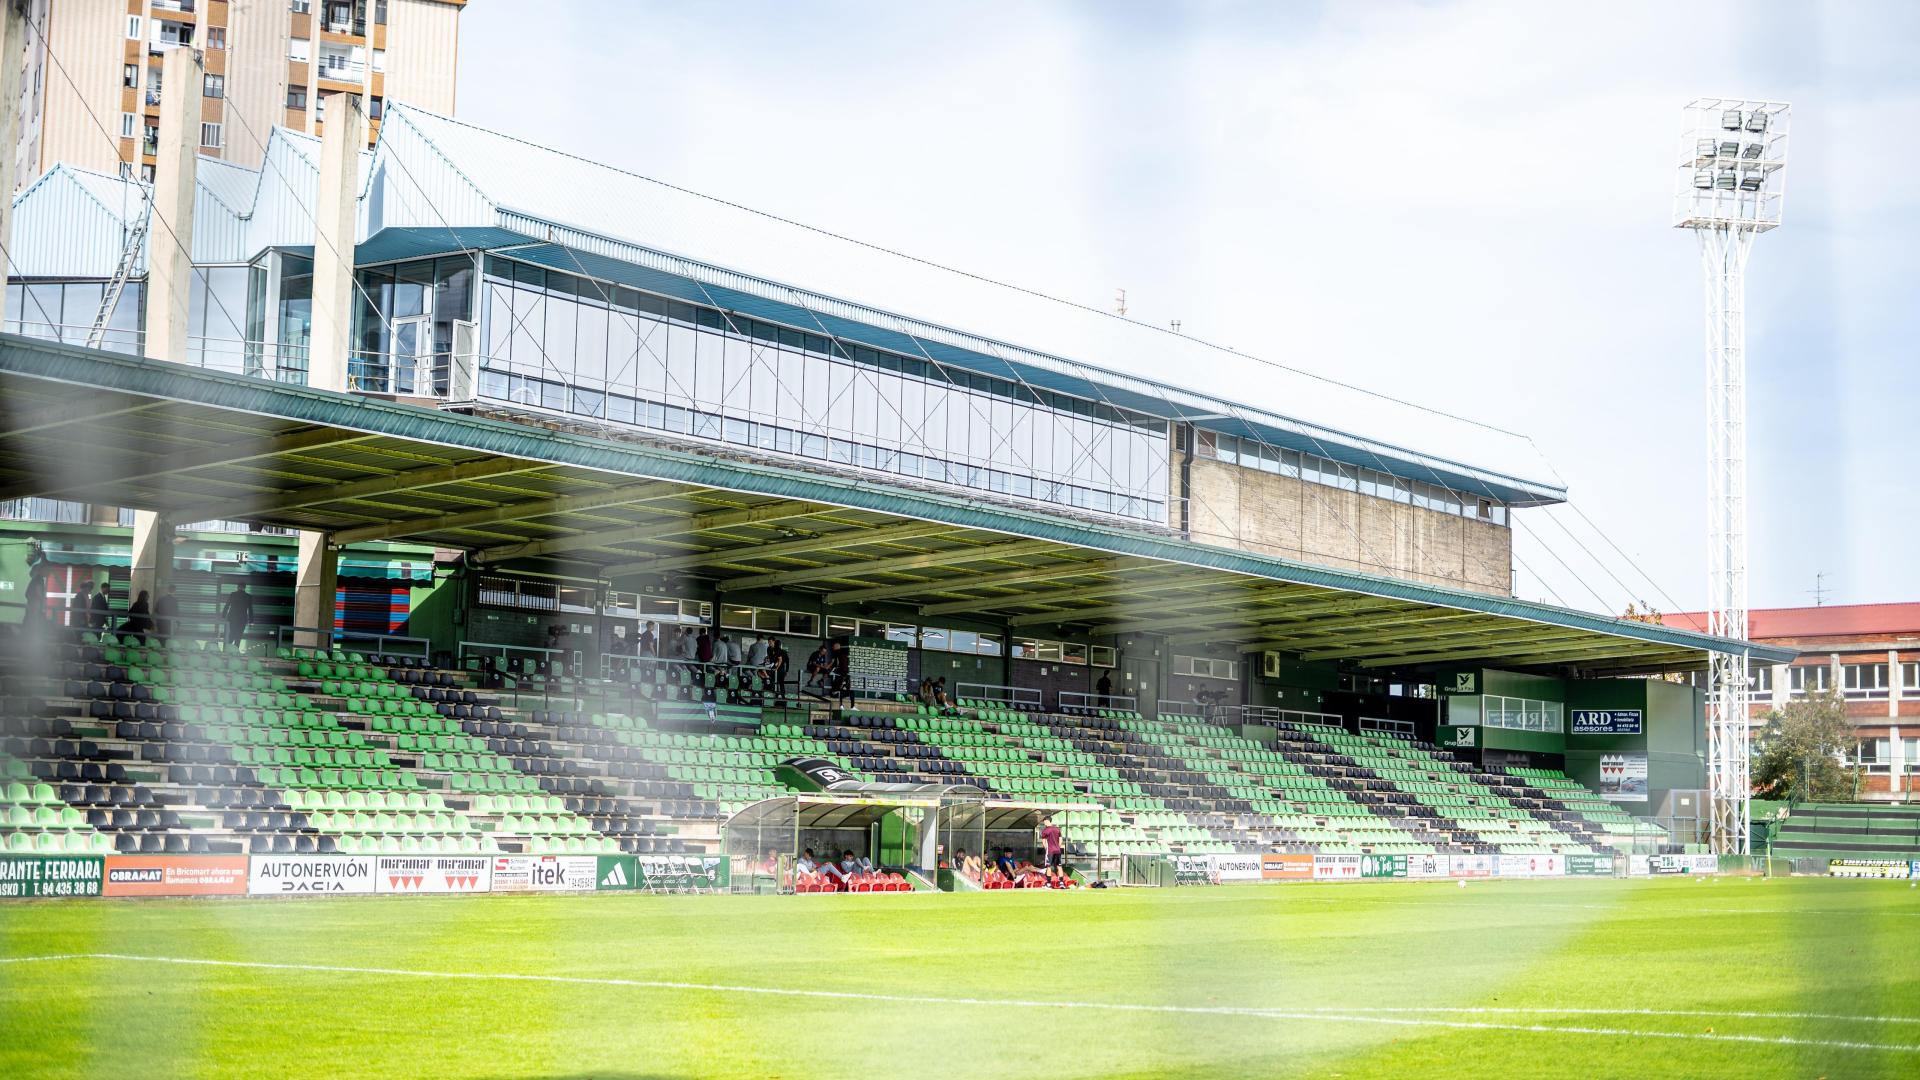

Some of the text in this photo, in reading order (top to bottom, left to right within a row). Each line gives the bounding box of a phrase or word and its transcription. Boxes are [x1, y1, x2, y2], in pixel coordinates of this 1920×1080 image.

[1576, 712, 1611, 725] ARD
[0, 860, 101, 880] RANTE FERRARA
[260, 858, 368, 878] AUTONERVIÓN
[380, 859, 430, 869] miramar
[437, 859, 485, 870] miramar
[1422, 858, 1437, 873] itek
[110, 871, 162, 881] OBRAMAT
[176, 867, 210, 876] Bricomart
[531, 862, 566, 885] itek
[0, 882, 19, 896] SKO
[33, 883, 41, 896] T.
[42, 882, 54, 895] 94
[55, 882, 72, 895] 435
[74, 881, 86, 895] 38
[86, 881, 98, 895] 68
[282, 881, 345, 891] DACIA
